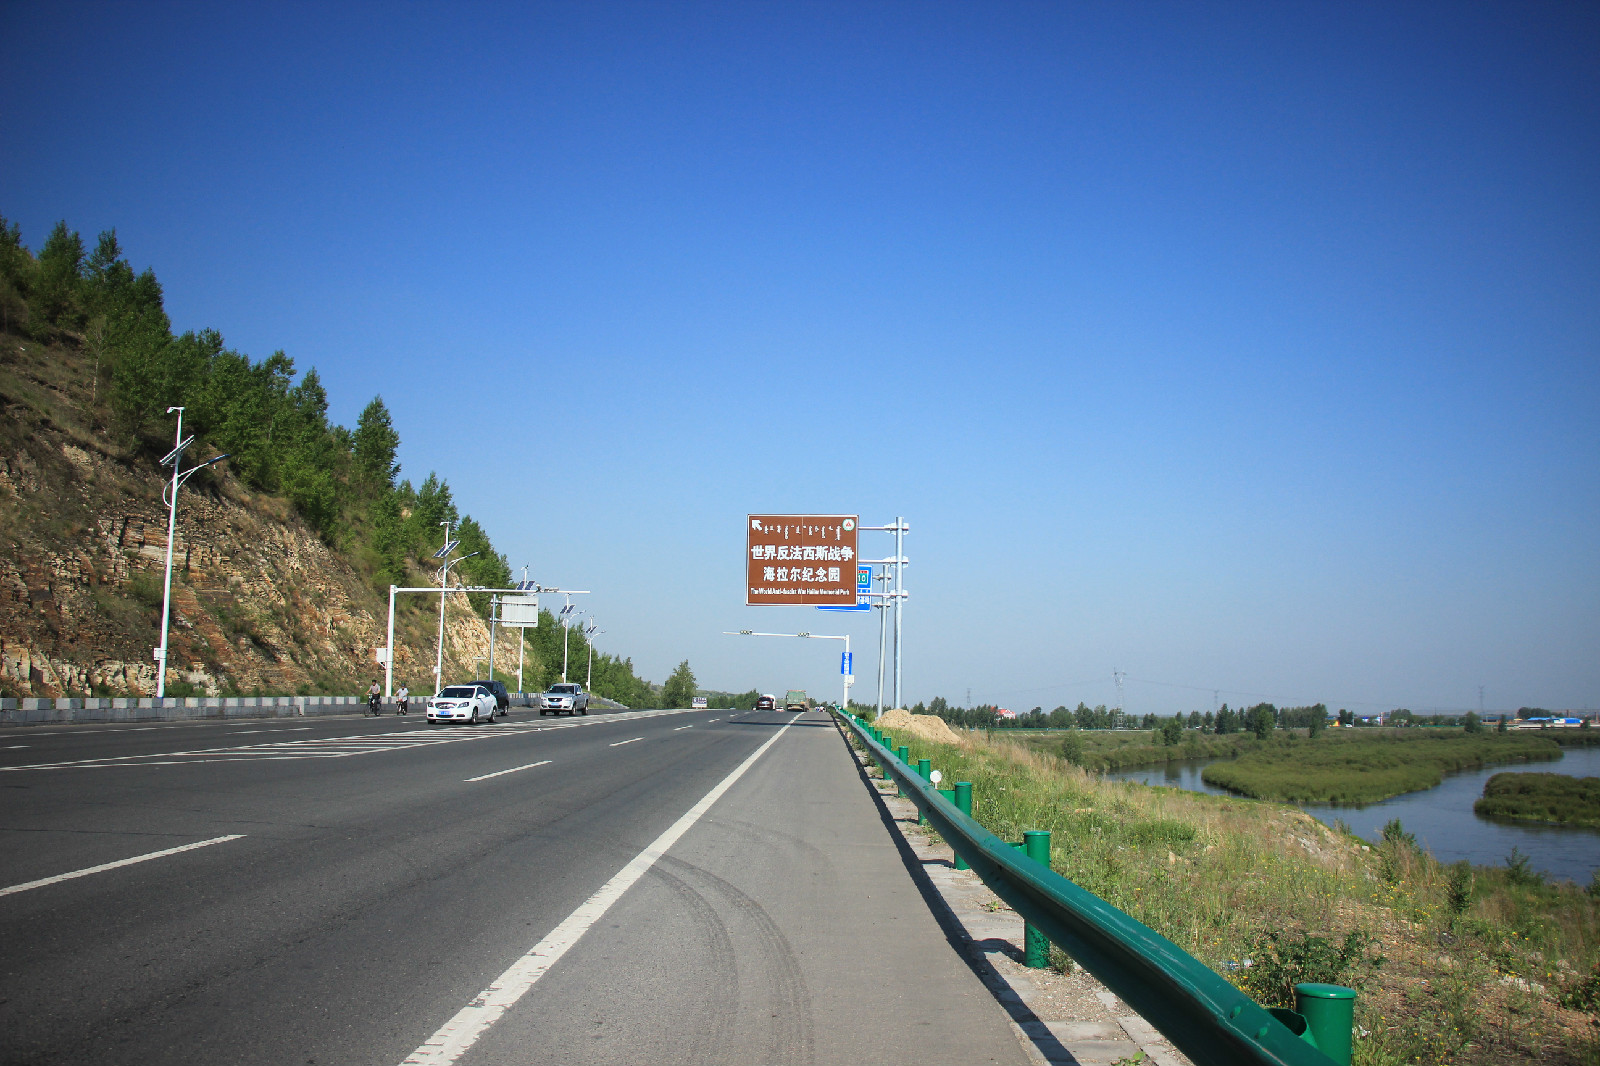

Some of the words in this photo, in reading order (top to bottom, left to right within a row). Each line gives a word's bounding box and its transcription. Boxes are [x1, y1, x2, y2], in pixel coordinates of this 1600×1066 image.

[751, 545, 854, 561] 世界反法西斯战争
[763, 566, 840, 582] 海拉尔纪念园
